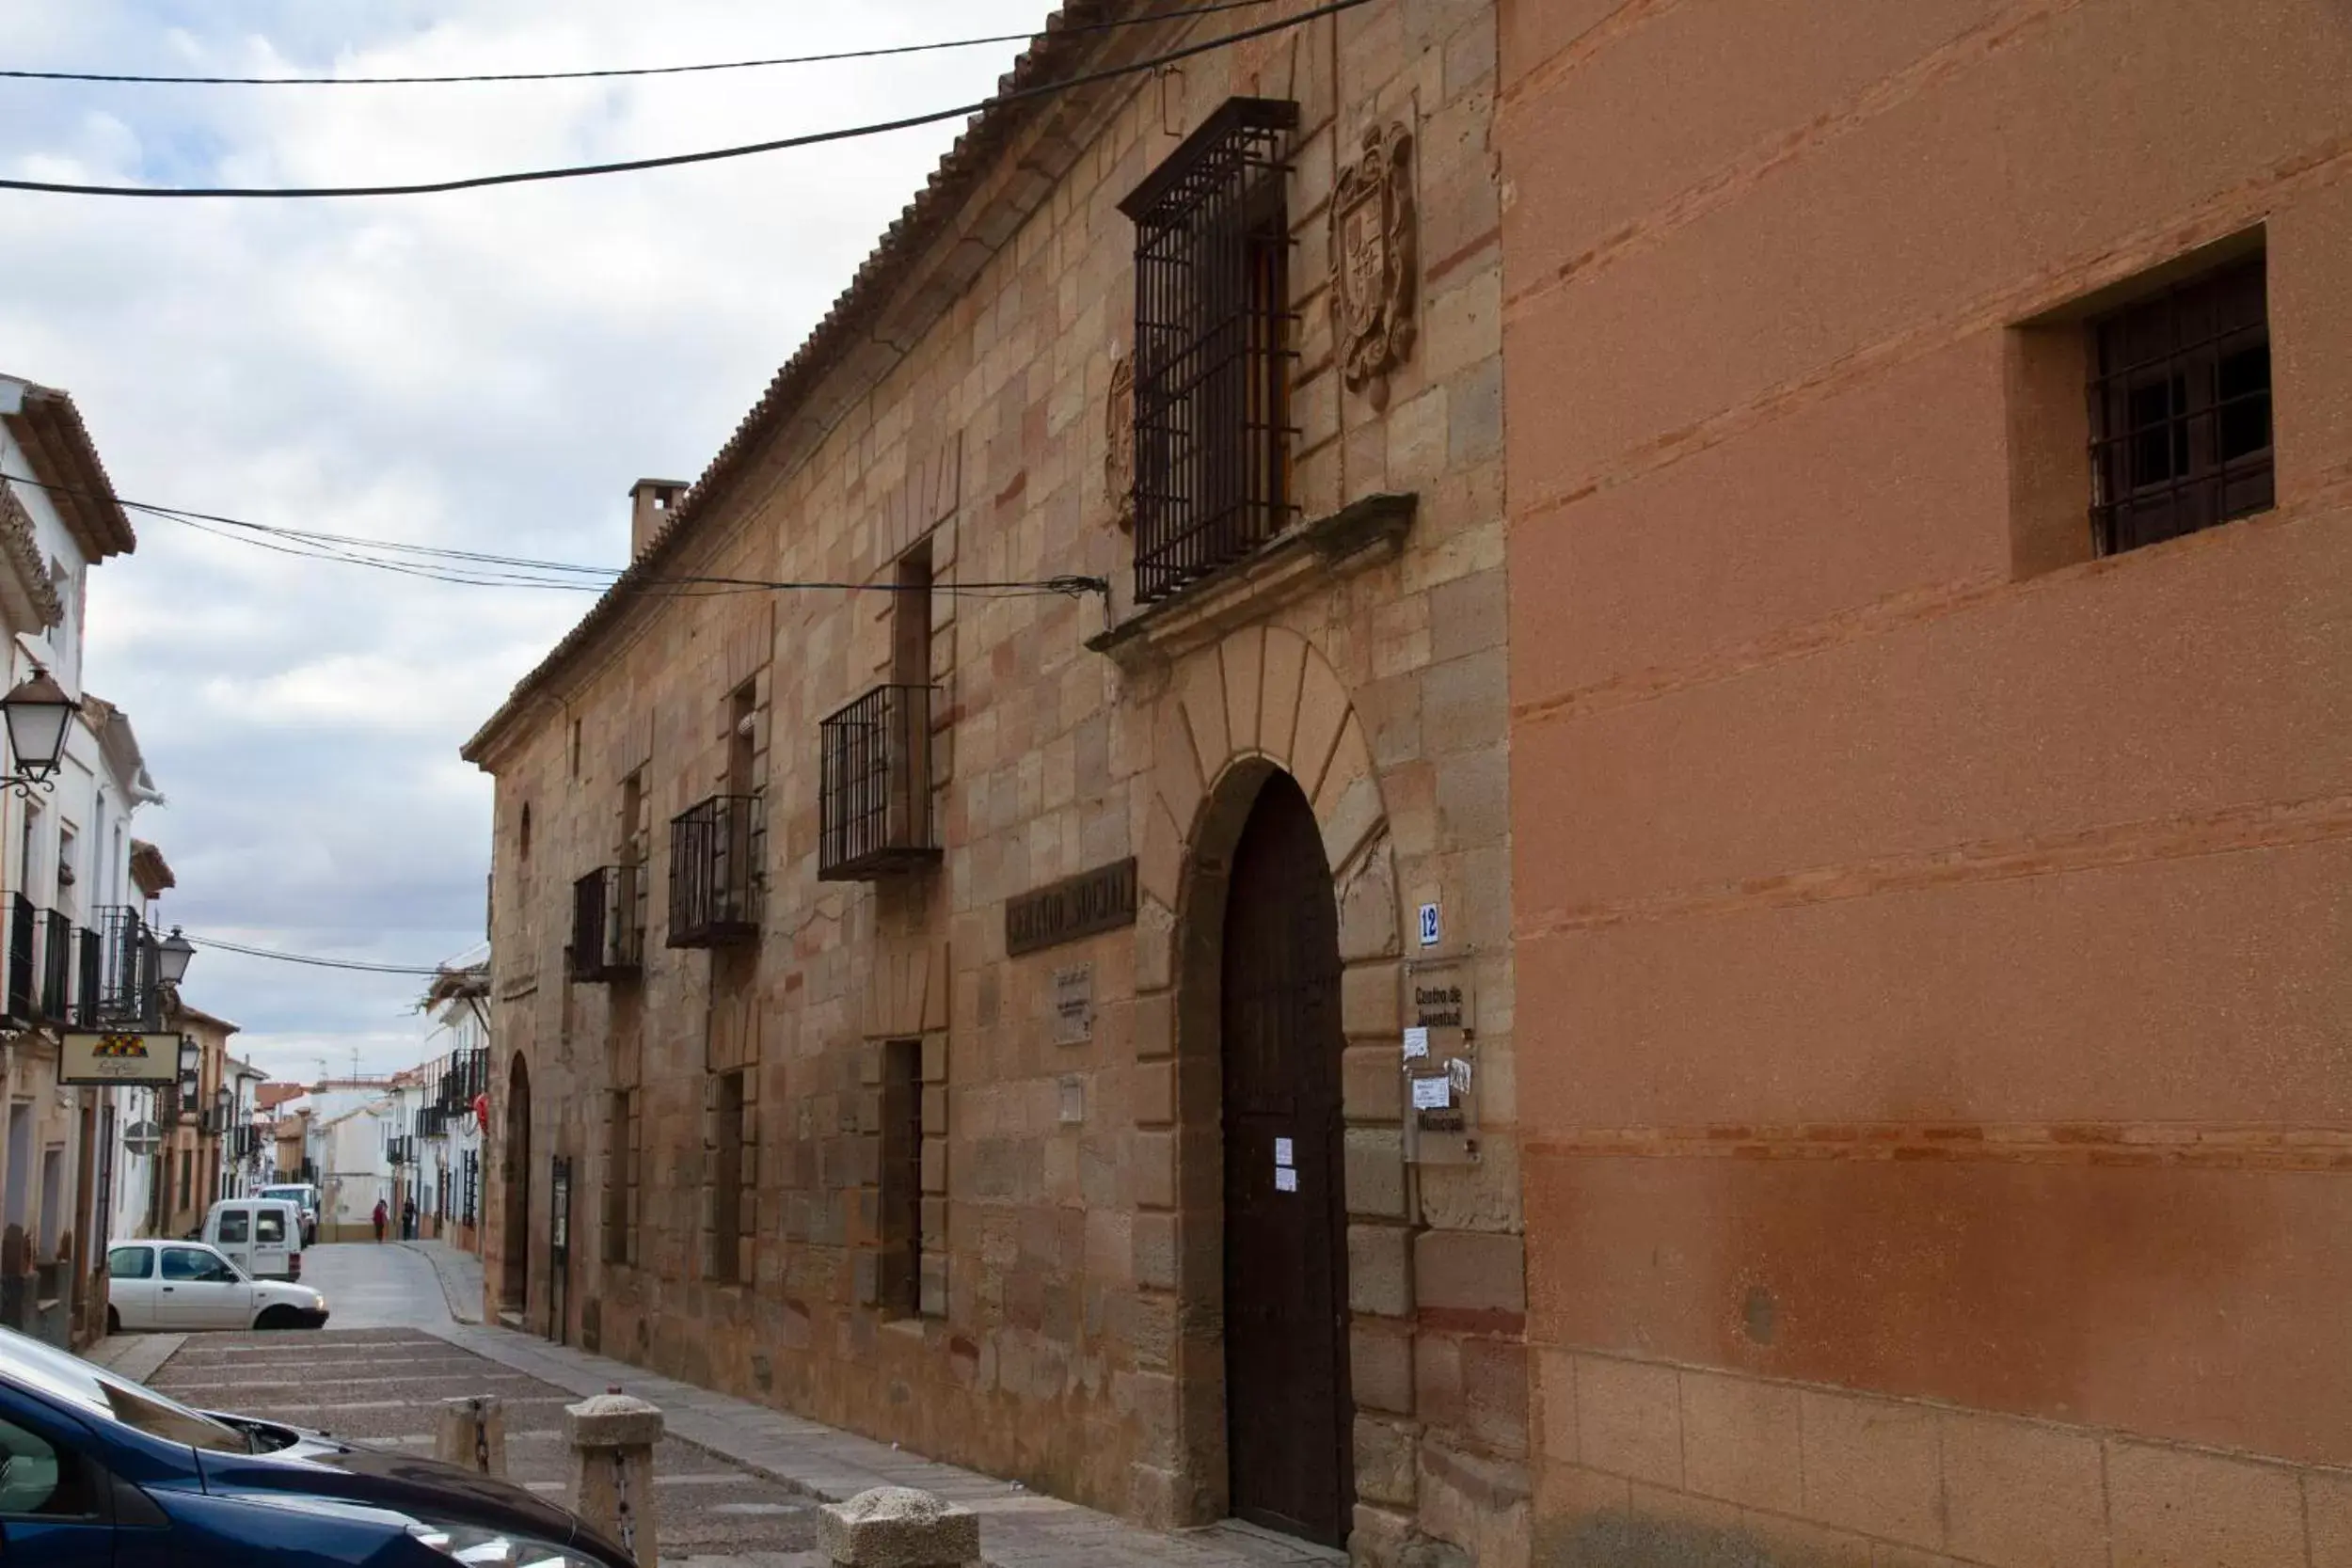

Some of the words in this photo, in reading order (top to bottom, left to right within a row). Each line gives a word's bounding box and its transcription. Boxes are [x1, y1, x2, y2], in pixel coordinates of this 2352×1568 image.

[1422, 908, 1437, 937] 12
[1416, 986, 1447, 1006] Centro
[1450, 985, 1463, 1004] de
